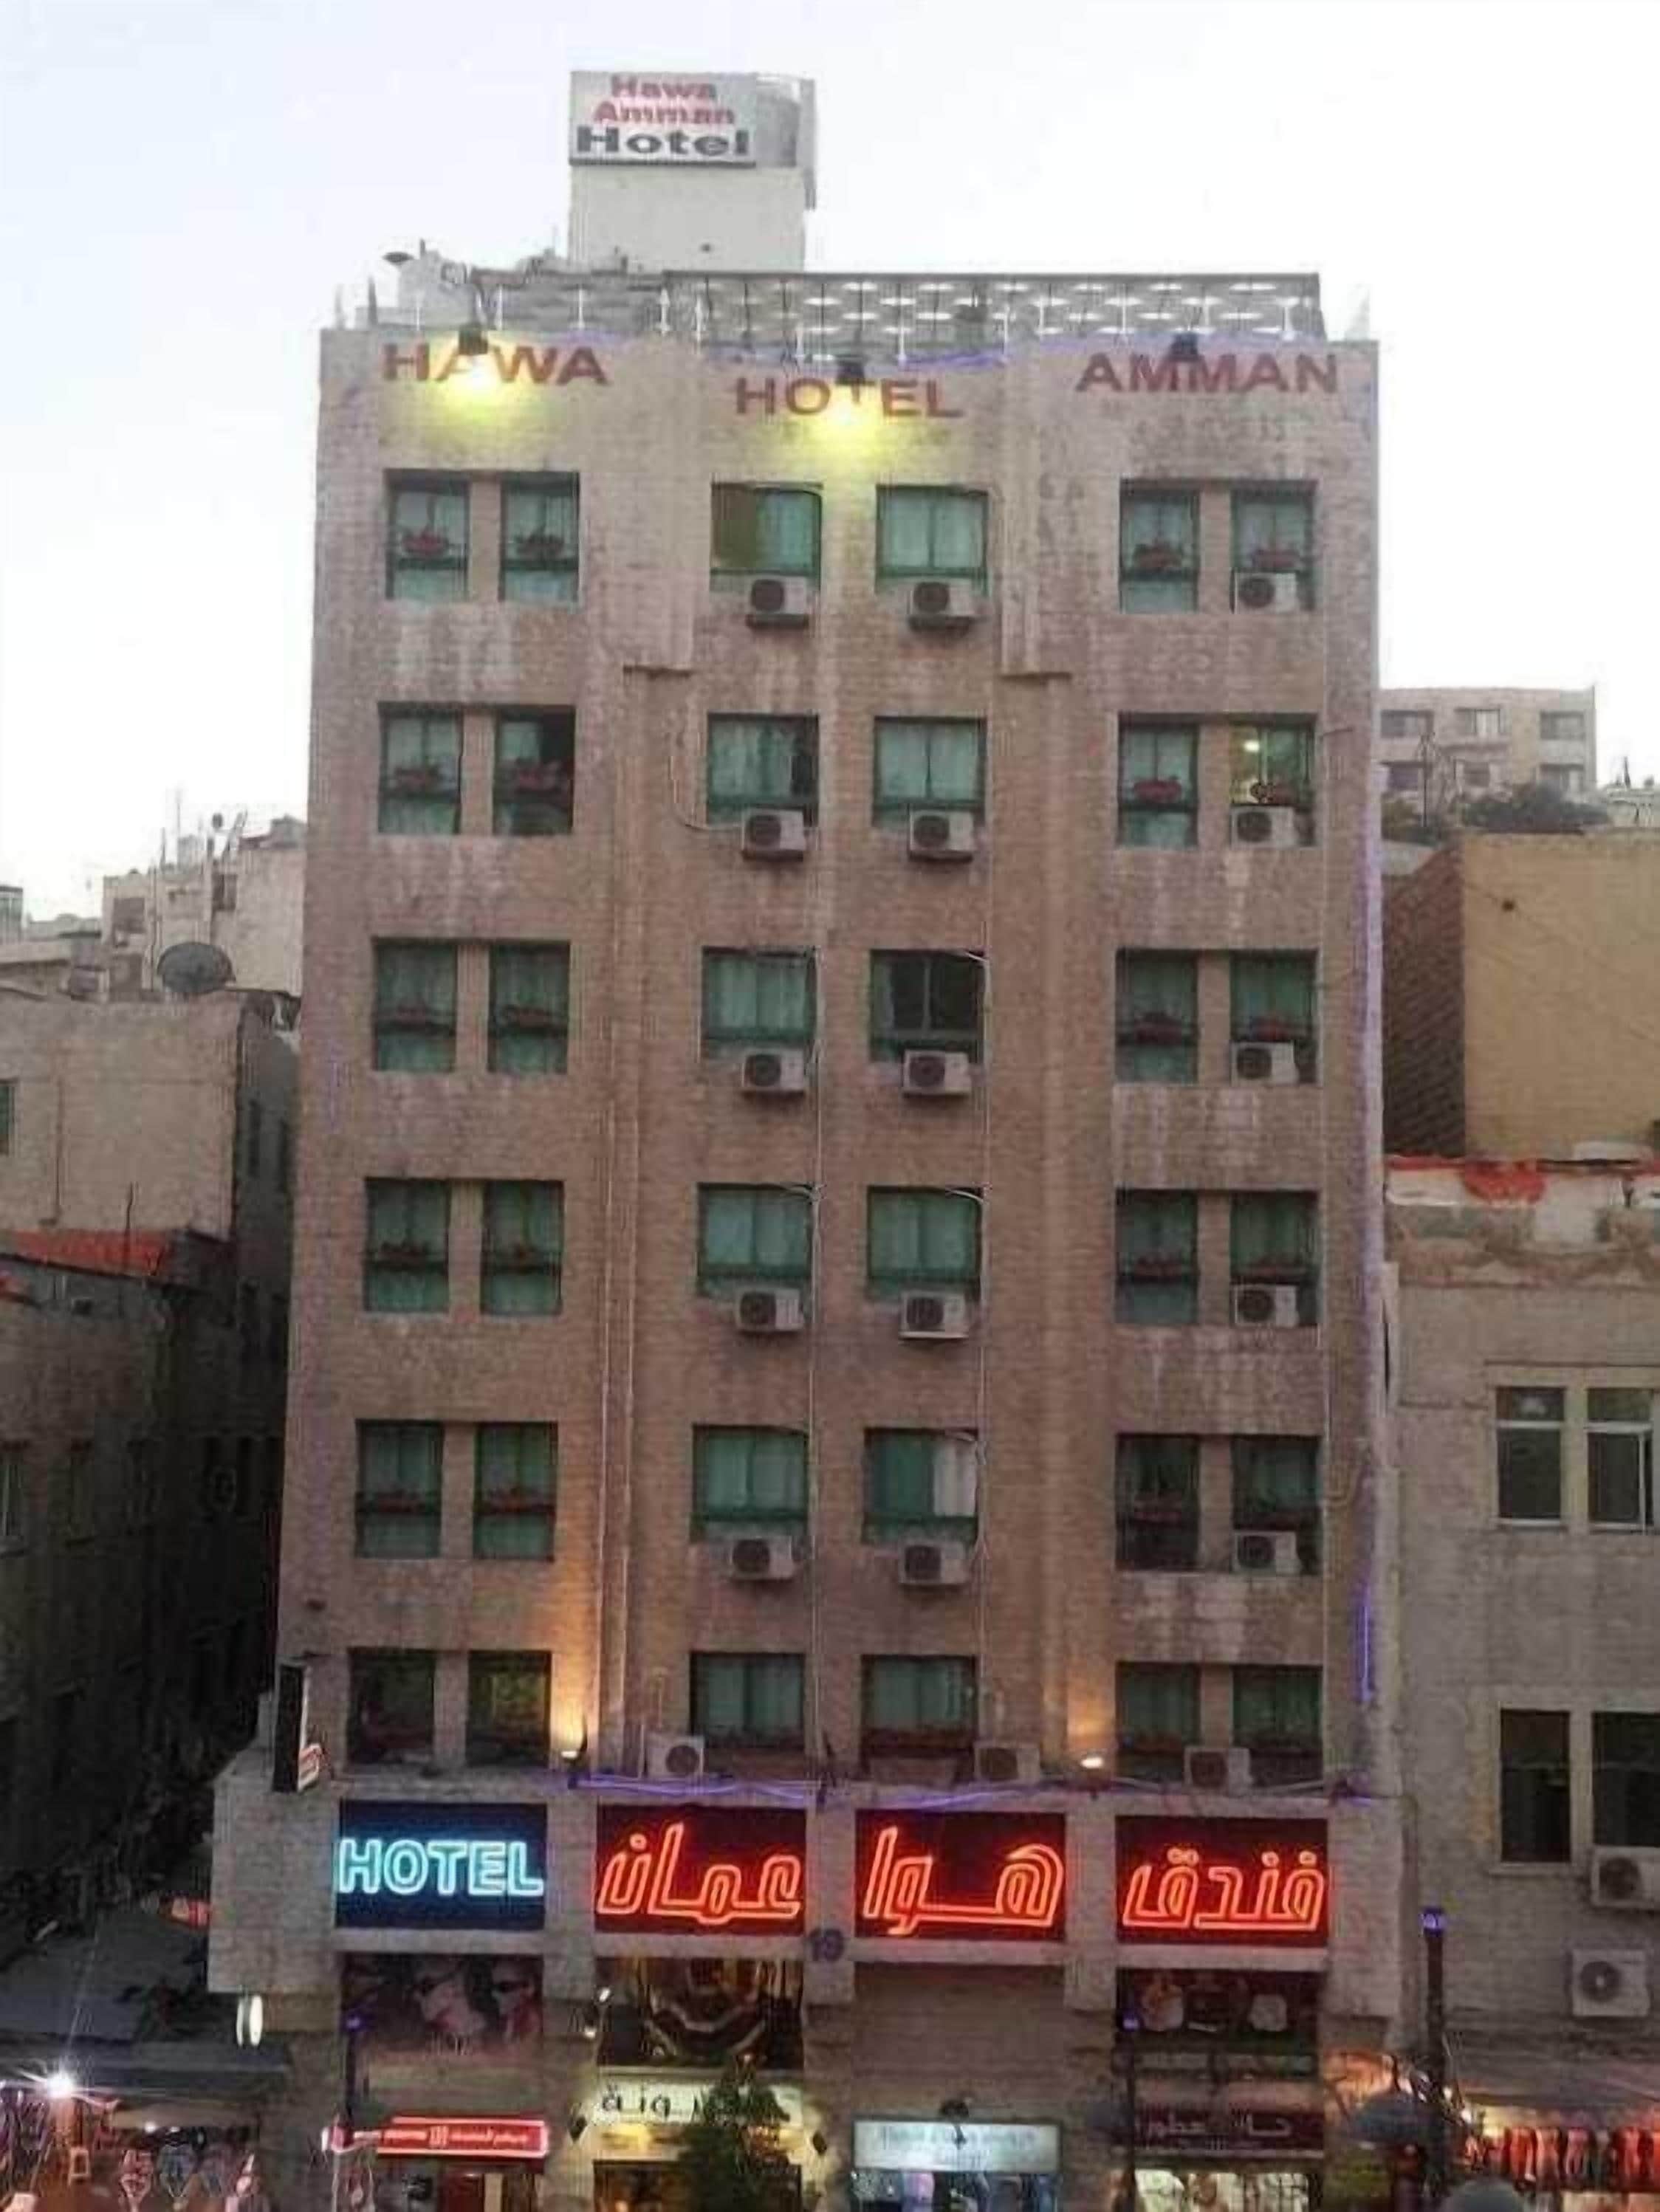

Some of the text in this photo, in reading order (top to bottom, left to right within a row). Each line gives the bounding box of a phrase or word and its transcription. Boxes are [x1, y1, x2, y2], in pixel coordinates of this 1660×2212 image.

[593, 101, 736, 124] Amman
[611, 75, 717, 98] Hawa
[577, 126, 749, 156] Hotel
[735, 377, 964, 418] HOTEL
[1075, 353, 1338, 393] AMMAN
[337, 1839, 545, 1896] HOTEL
[596, 1821, 802, 1925] عمان
[1122, 1847, 1325, 1931] فندق
